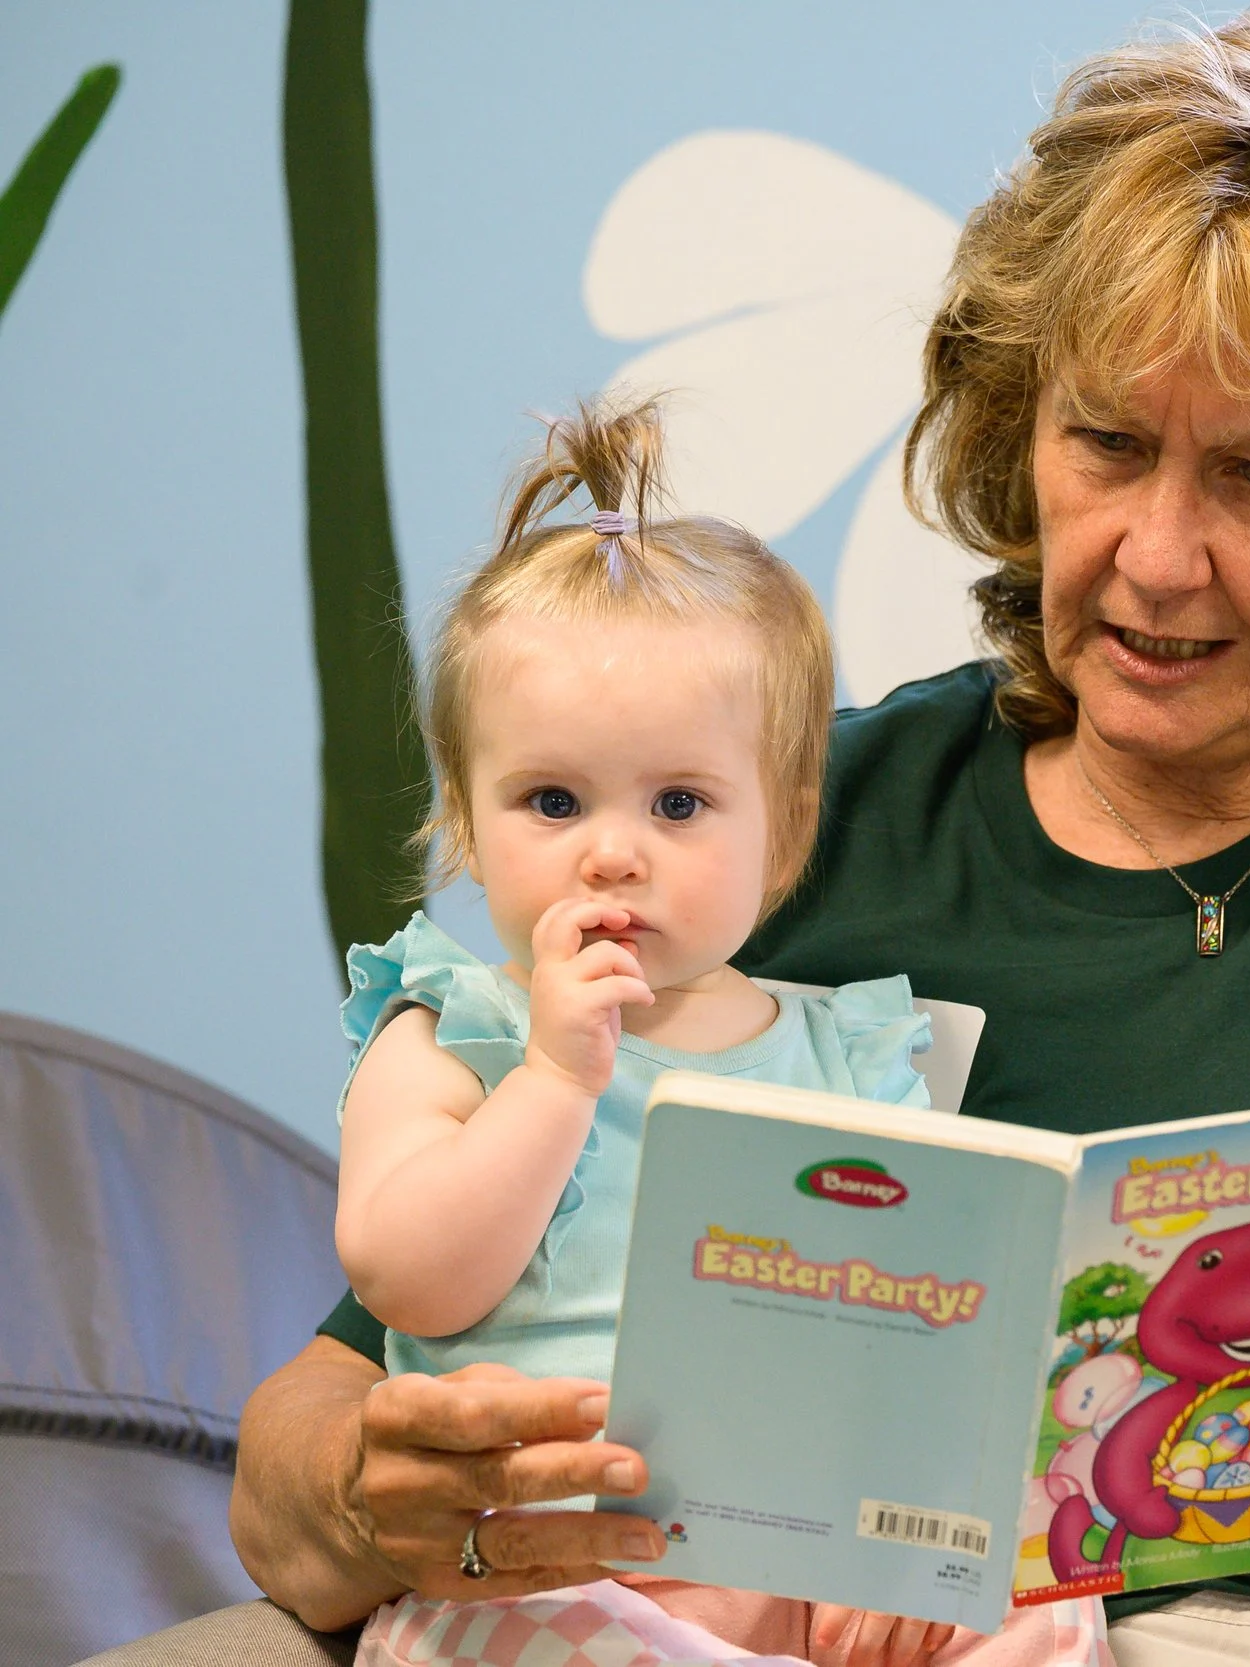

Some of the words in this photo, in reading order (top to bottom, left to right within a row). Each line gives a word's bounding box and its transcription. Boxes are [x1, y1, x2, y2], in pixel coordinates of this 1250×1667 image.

[821, 1170, 902, 1204] Barney
[701, 1242, 841, 1294] Easter
[847, 1263, 980, 1321] Party!
[1028, 1574, 1121, 1596] SCHOLASTIC
